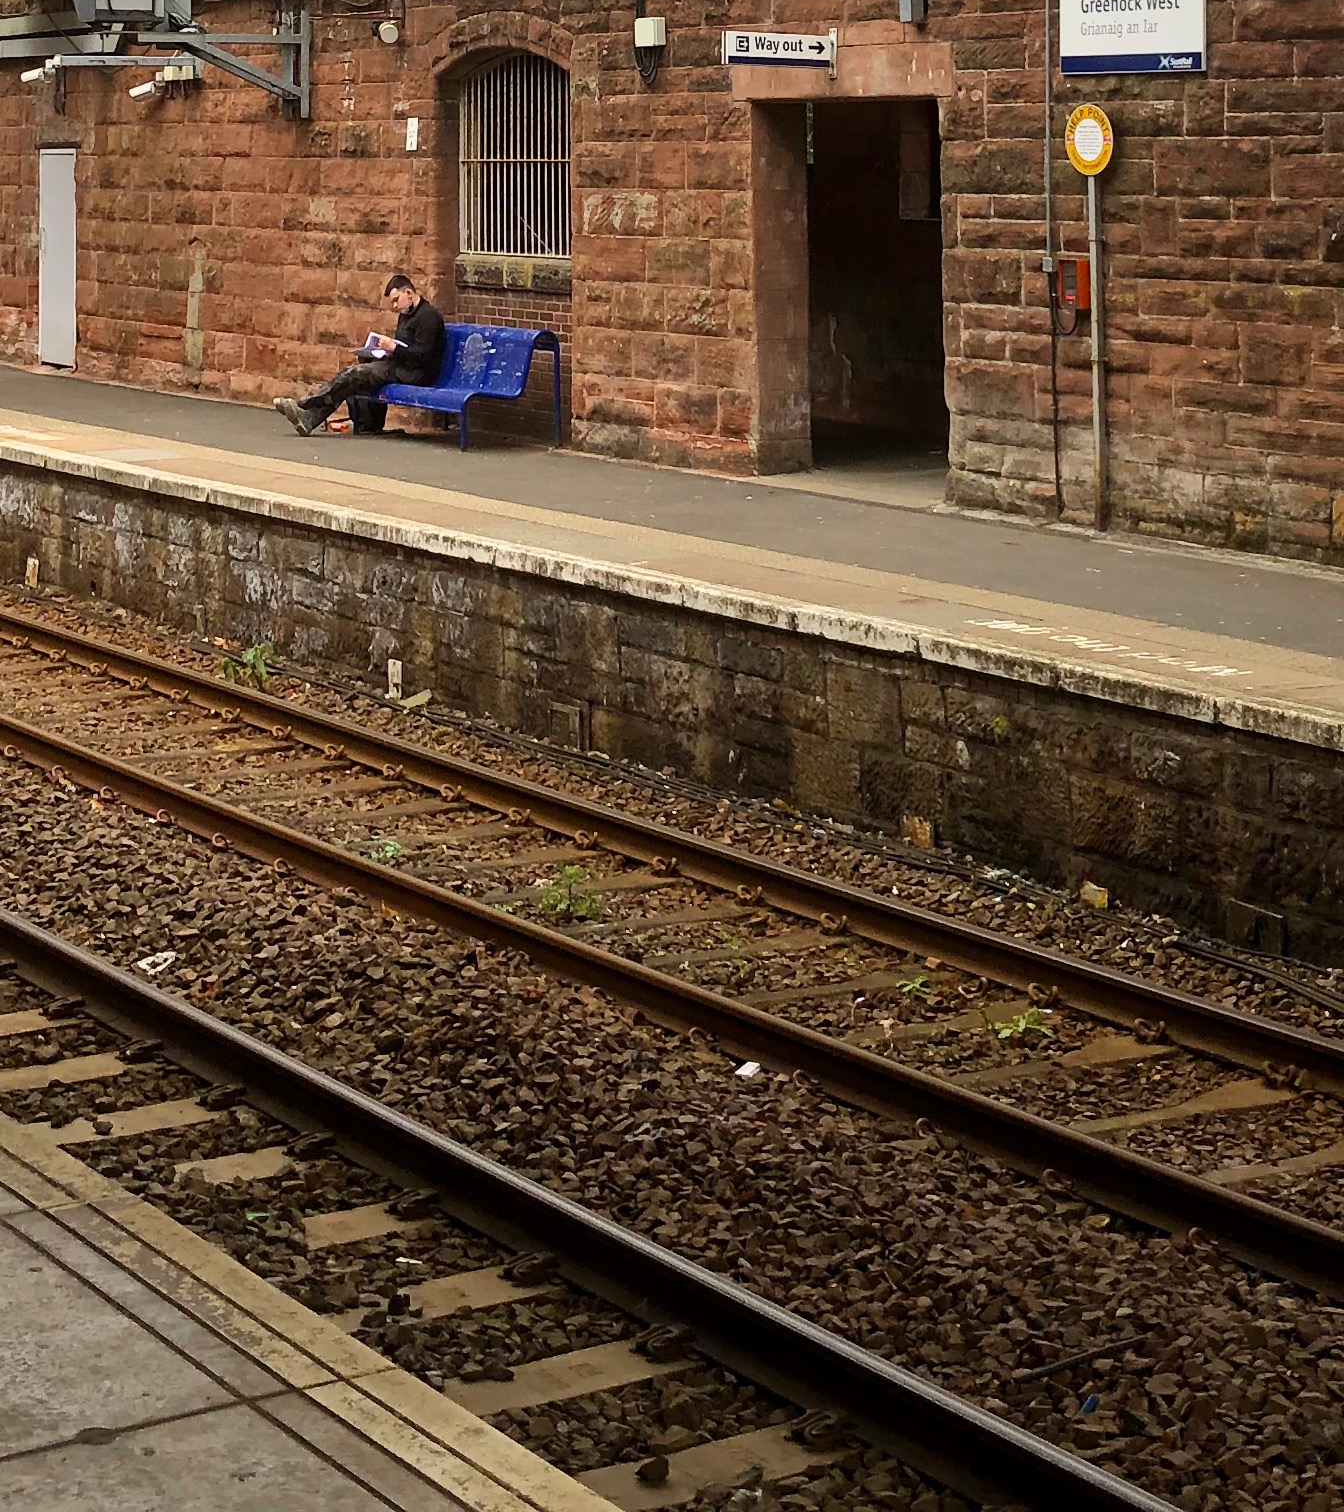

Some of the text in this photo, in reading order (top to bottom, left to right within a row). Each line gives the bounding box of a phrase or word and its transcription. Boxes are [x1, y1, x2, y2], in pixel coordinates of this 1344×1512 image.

[1080, 20, 1123, 38] Grianaig
[1126, 22, 1139, 34] an
[755, 36, 803, 54] Way out
